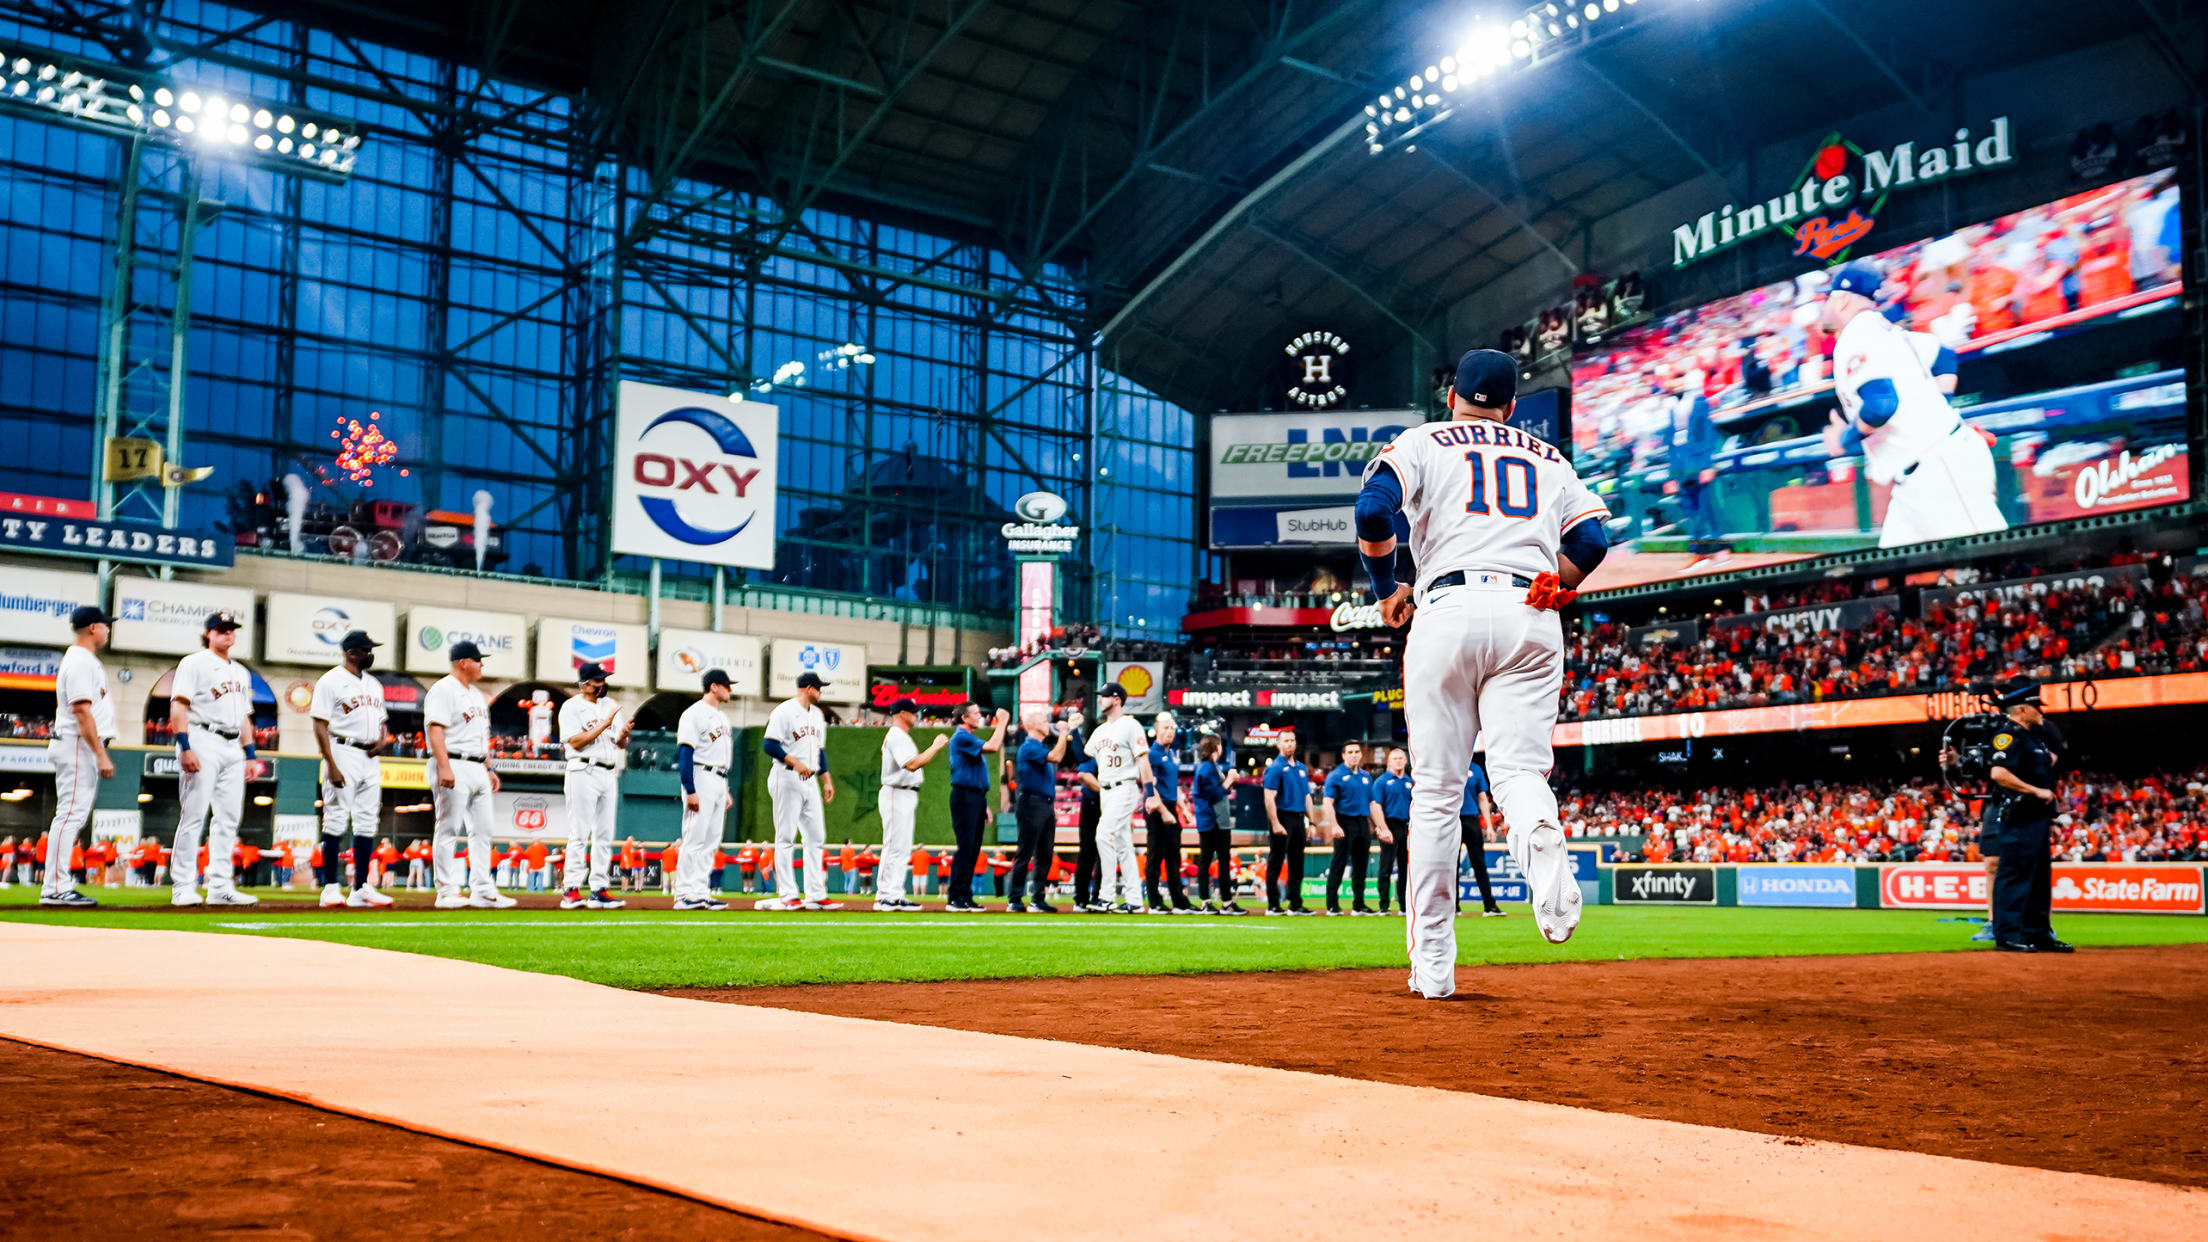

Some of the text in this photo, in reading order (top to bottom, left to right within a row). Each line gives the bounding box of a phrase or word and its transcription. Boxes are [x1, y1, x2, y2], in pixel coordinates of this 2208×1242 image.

[1672, 115, 2012, 266] Minute Maid
[1284, 331, 1350, 357] HOUSTON
[1302, 355, 1332, 383] H
[1287, 384, 1347, 407] ASTROS
[1429, 424, 1562, 464] GURRIEL
[119, 448, 148, 469] 17
[634, 452, 761, 498] OXY
[1464, 450, 1539, 520] 10
[1001, 522, 1080, 540] Gallagher
[1288, 519, 1348, 532] StubHub
[2, 518, 217, 559] TY LEADERS
[1008, 540, 1072, 551] INSURANCE
[572, 624, 617, 637] Chevron
[1182, 690, 1250, 707] impact
[1270, 690, 1339, 707] impact
[1677, 712, 1705, 738] 10
[1107, 756, 1122, 767] 30
[519, 812, 541, 825] 66
[1632, 871, 1696, 898] xfinity
[1761, 879, 1850, 893] HONDA
